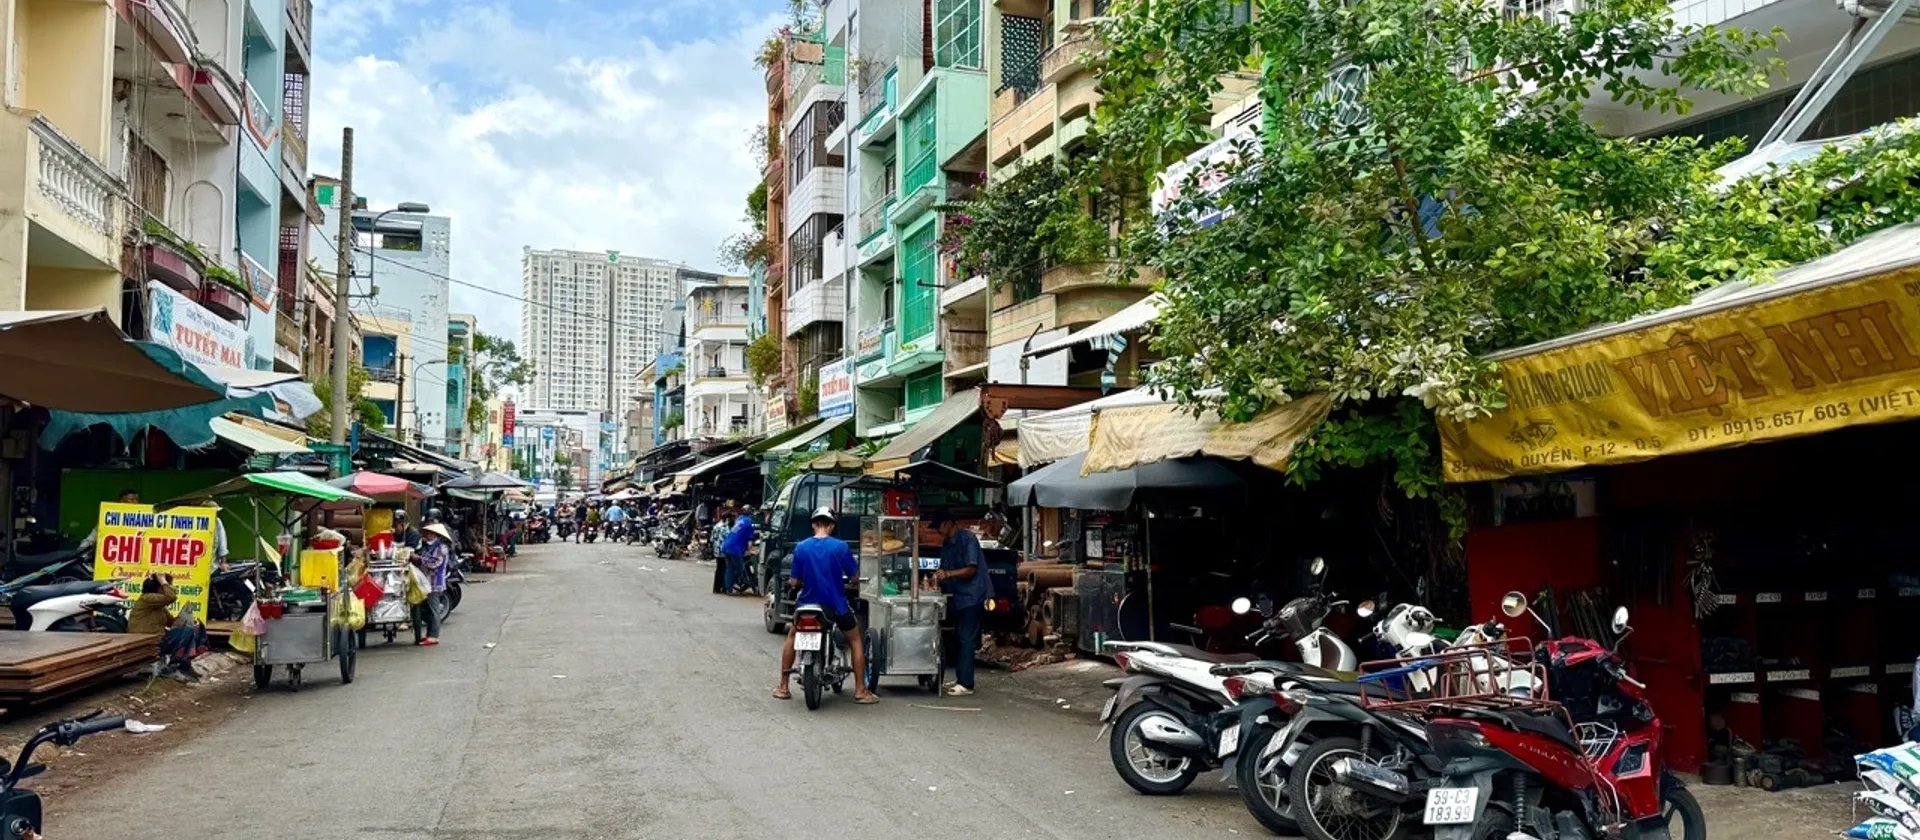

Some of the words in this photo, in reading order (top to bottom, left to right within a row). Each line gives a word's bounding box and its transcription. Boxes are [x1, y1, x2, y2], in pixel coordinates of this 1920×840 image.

[1612, 331, 1767, 418] VIỆT
[1722, 401, 1852, 437] 0915.657.603
[105, 511, 120, 526] CHI
[156, 513, 169, 529] CT
[171, 515, 194, 530] TNHH
[197, 516, 210, 531] TM
[1433, 789, 1471, 806] 59-C3
[1428, 805, 1472, 822] 183.99
